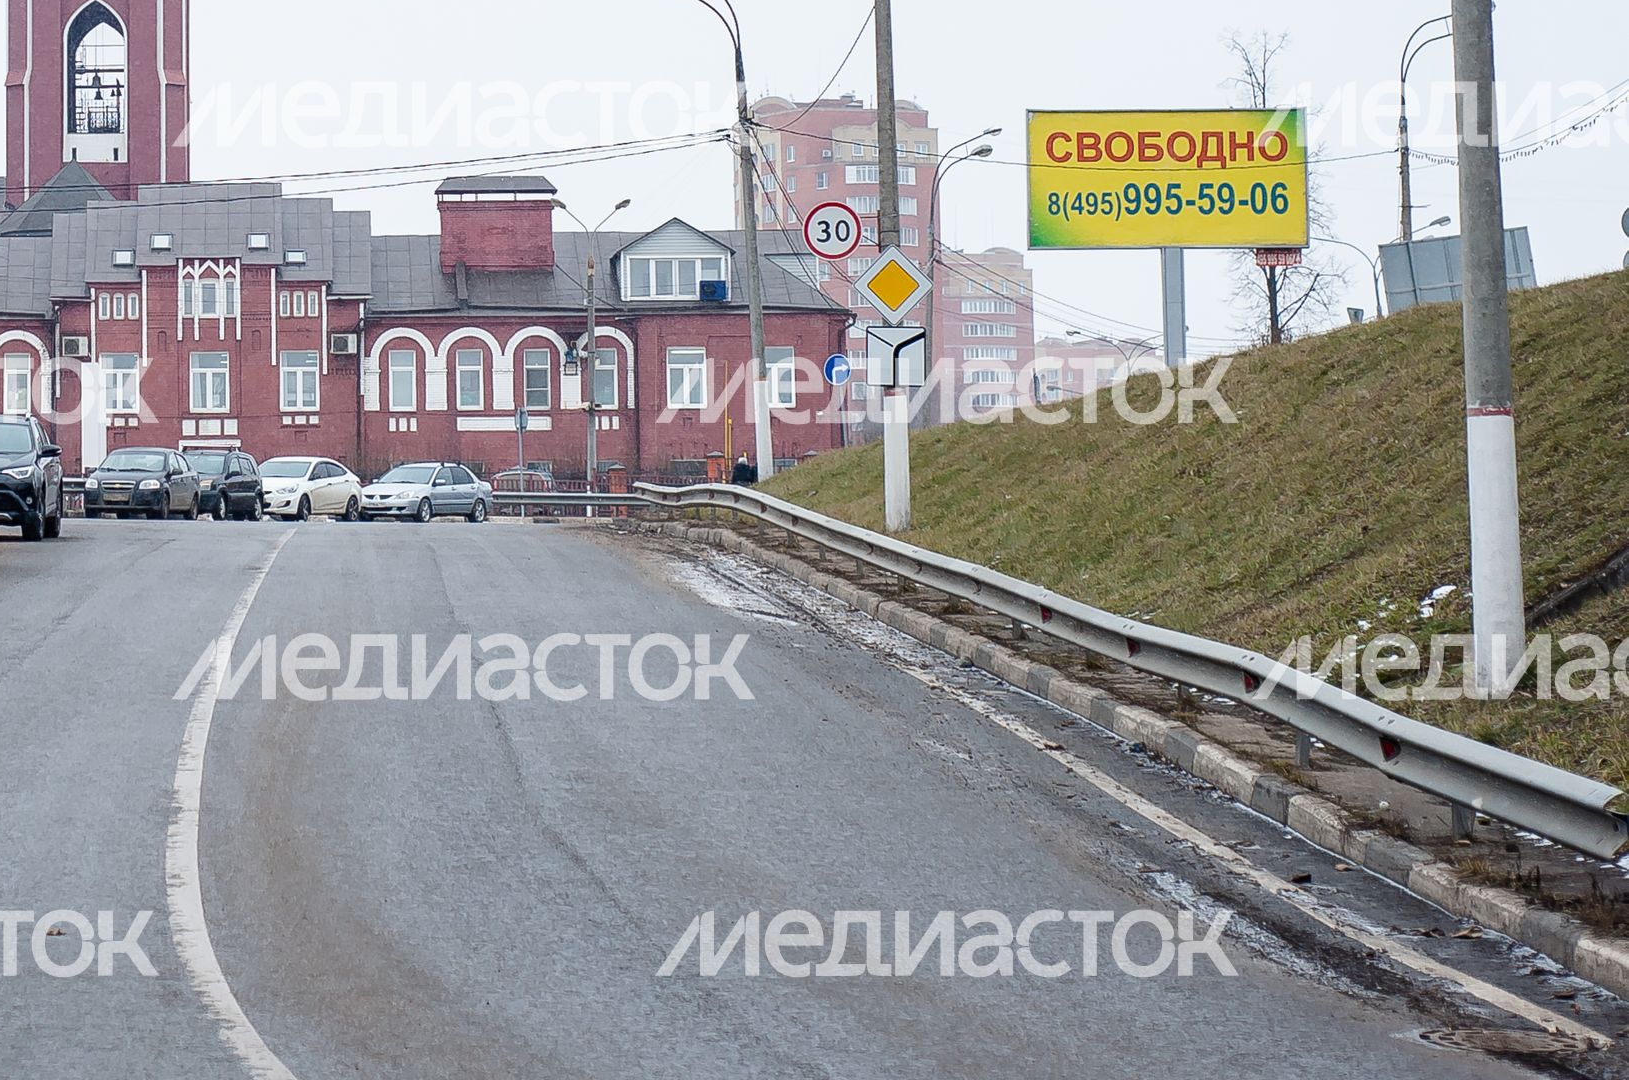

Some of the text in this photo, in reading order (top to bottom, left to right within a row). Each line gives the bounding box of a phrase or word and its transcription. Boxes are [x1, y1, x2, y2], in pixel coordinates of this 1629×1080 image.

[1046, 131, 1288, 169] СВОБОДНО
[1047, 181, 1289, 221] 8(495)995-59-06
[816, 220, 850, 243] 30
